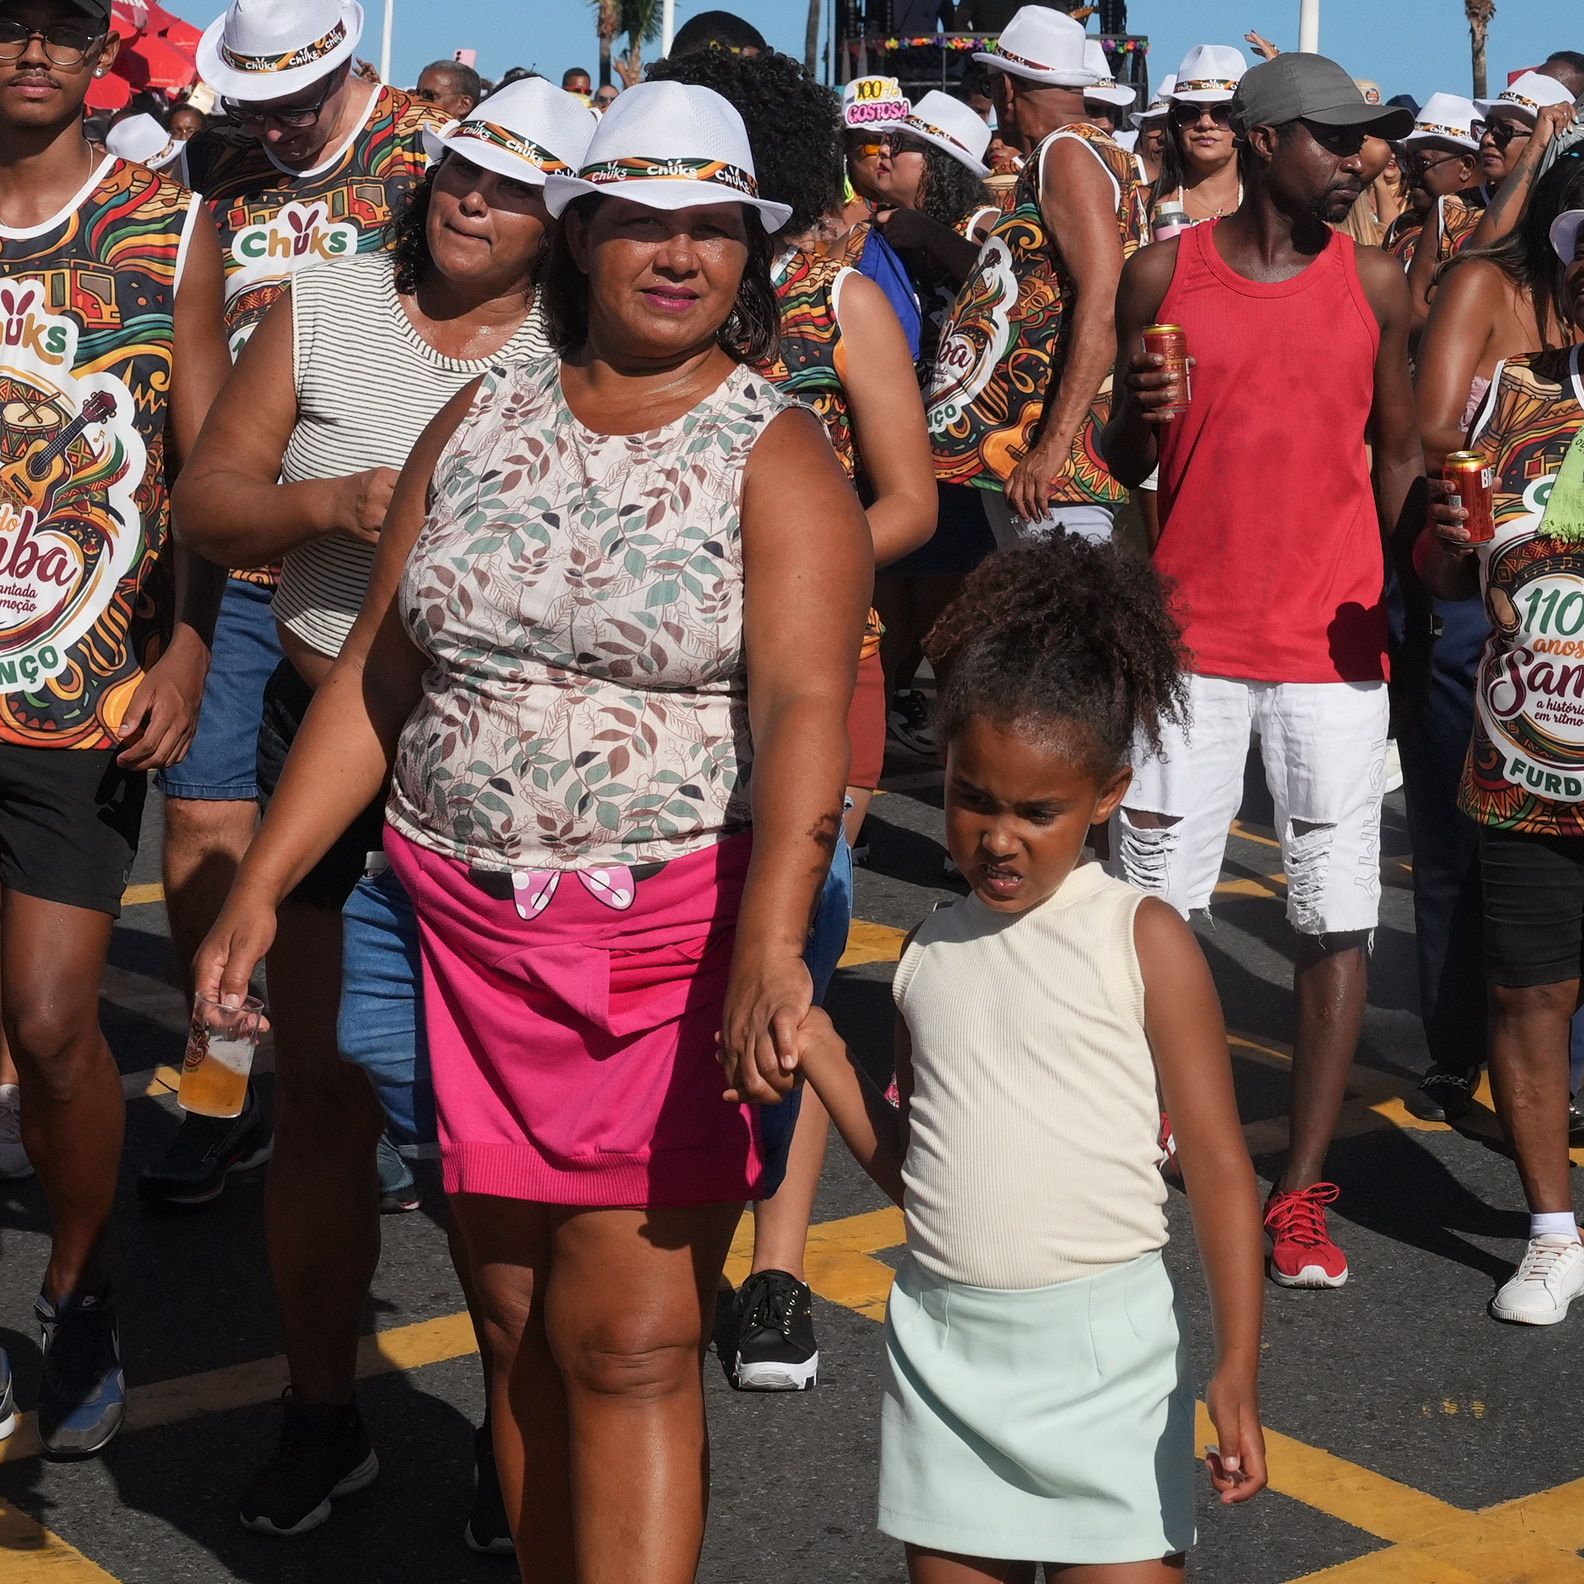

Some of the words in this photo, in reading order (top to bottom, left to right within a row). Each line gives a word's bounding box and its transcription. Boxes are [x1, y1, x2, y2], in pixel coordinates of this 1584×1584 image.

[1536, 699, 1545, 710] a
[1534, 711, 1552, 721] em
[1553, 710, 1584, 728] ritmo
